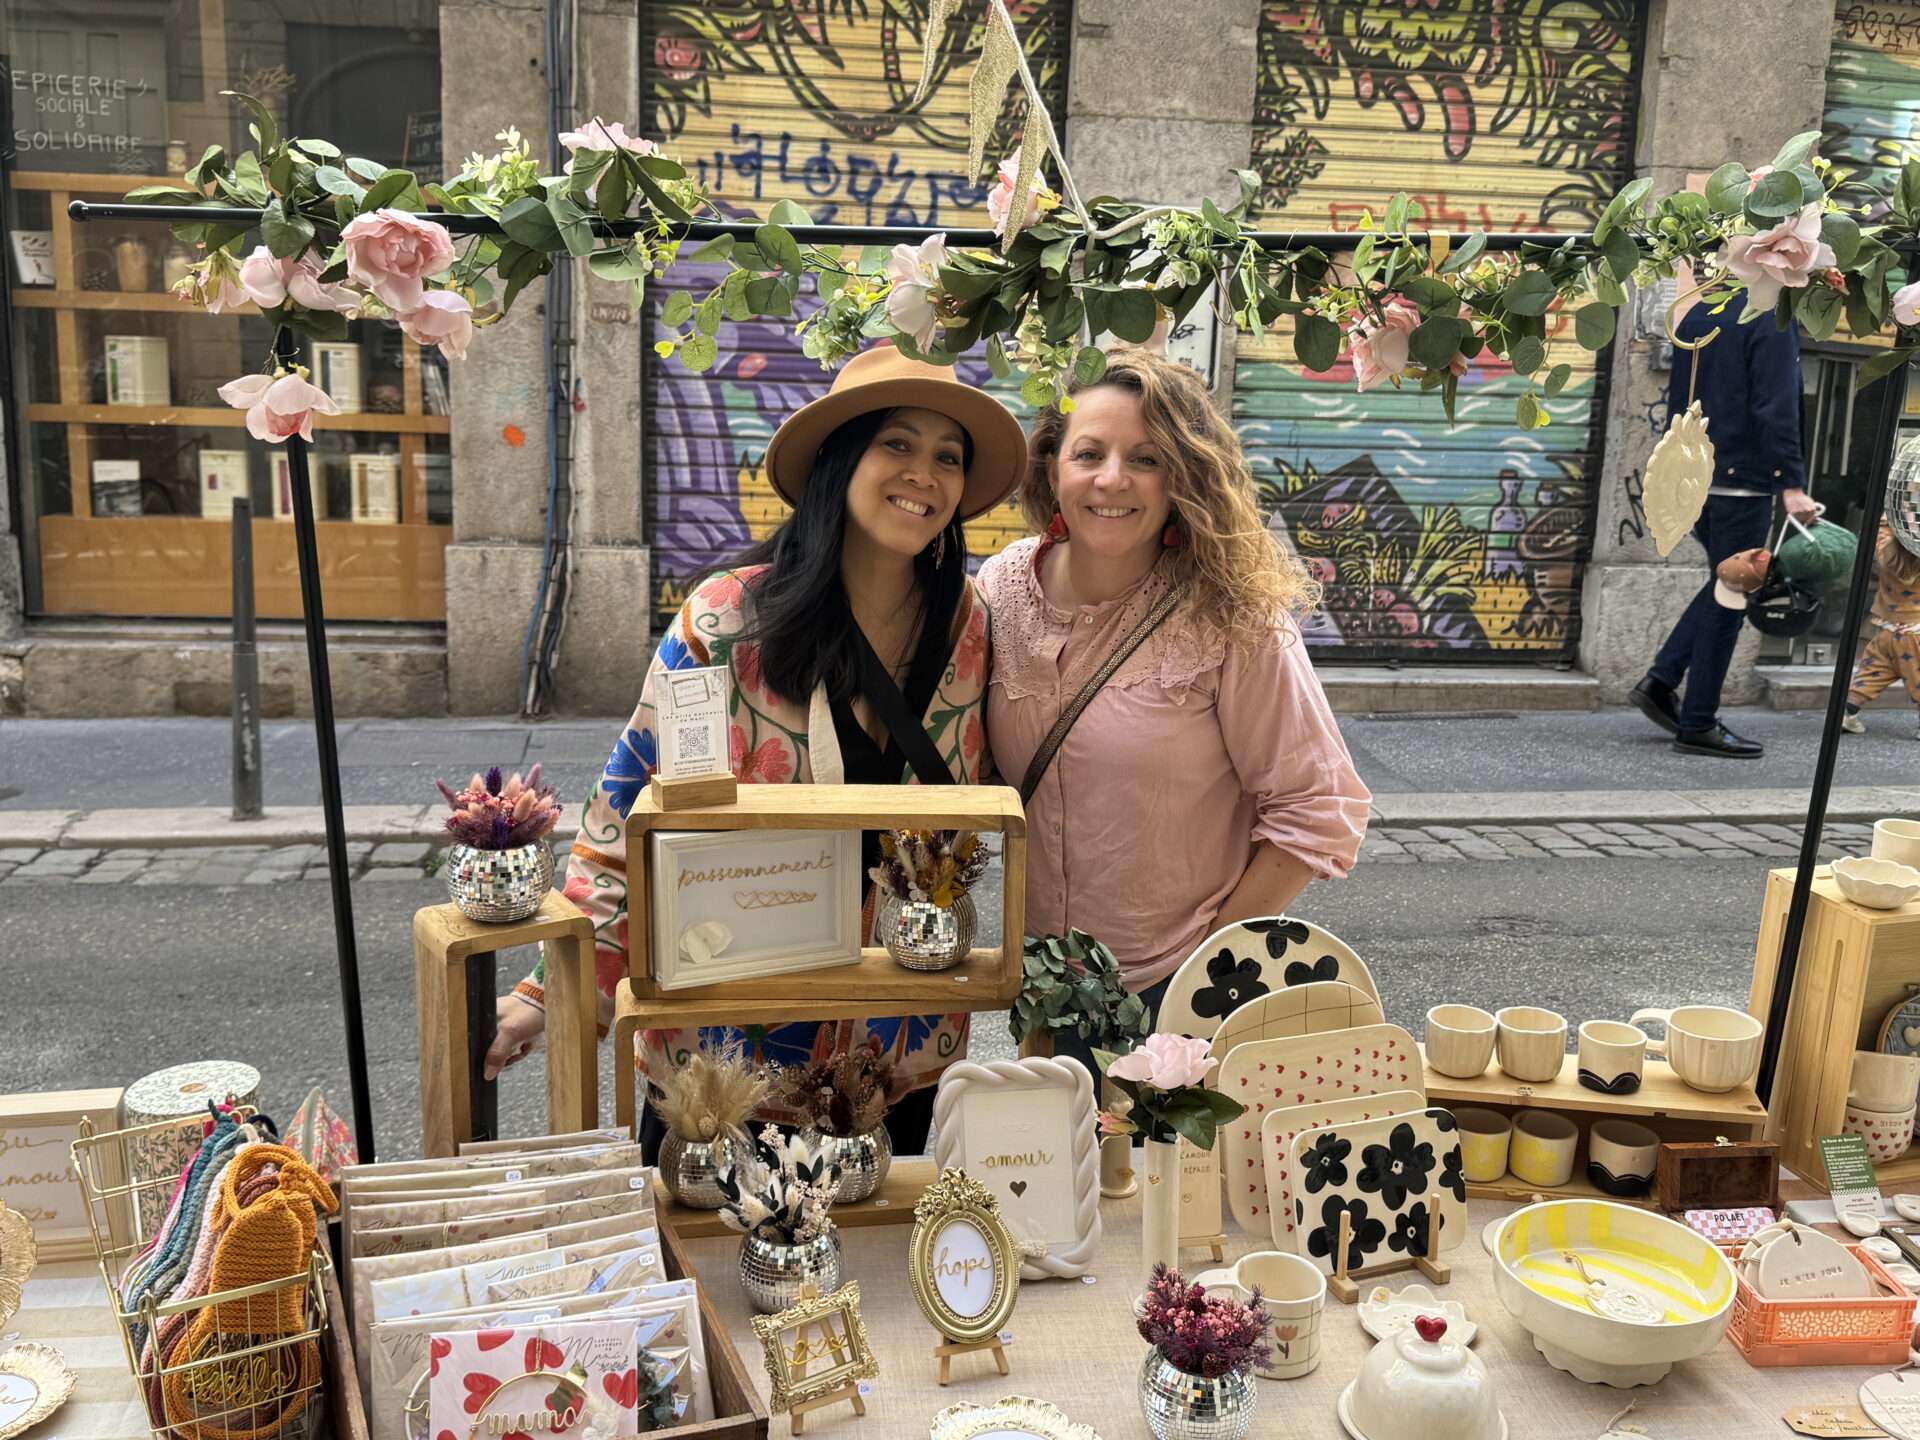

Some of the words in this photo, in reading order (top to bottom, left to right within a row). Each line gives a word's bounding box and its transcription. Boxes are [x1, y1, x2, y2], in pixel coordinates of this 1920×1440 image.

[11, 70, 126, 99] EPICERIE
[35, 97, 113, 116] SOCIALE
[14, 128, 142, 153] SOLIDAIRE
[978, 1149, 1055, 1168] amour
[934, 1246, 993, 1288] hope
